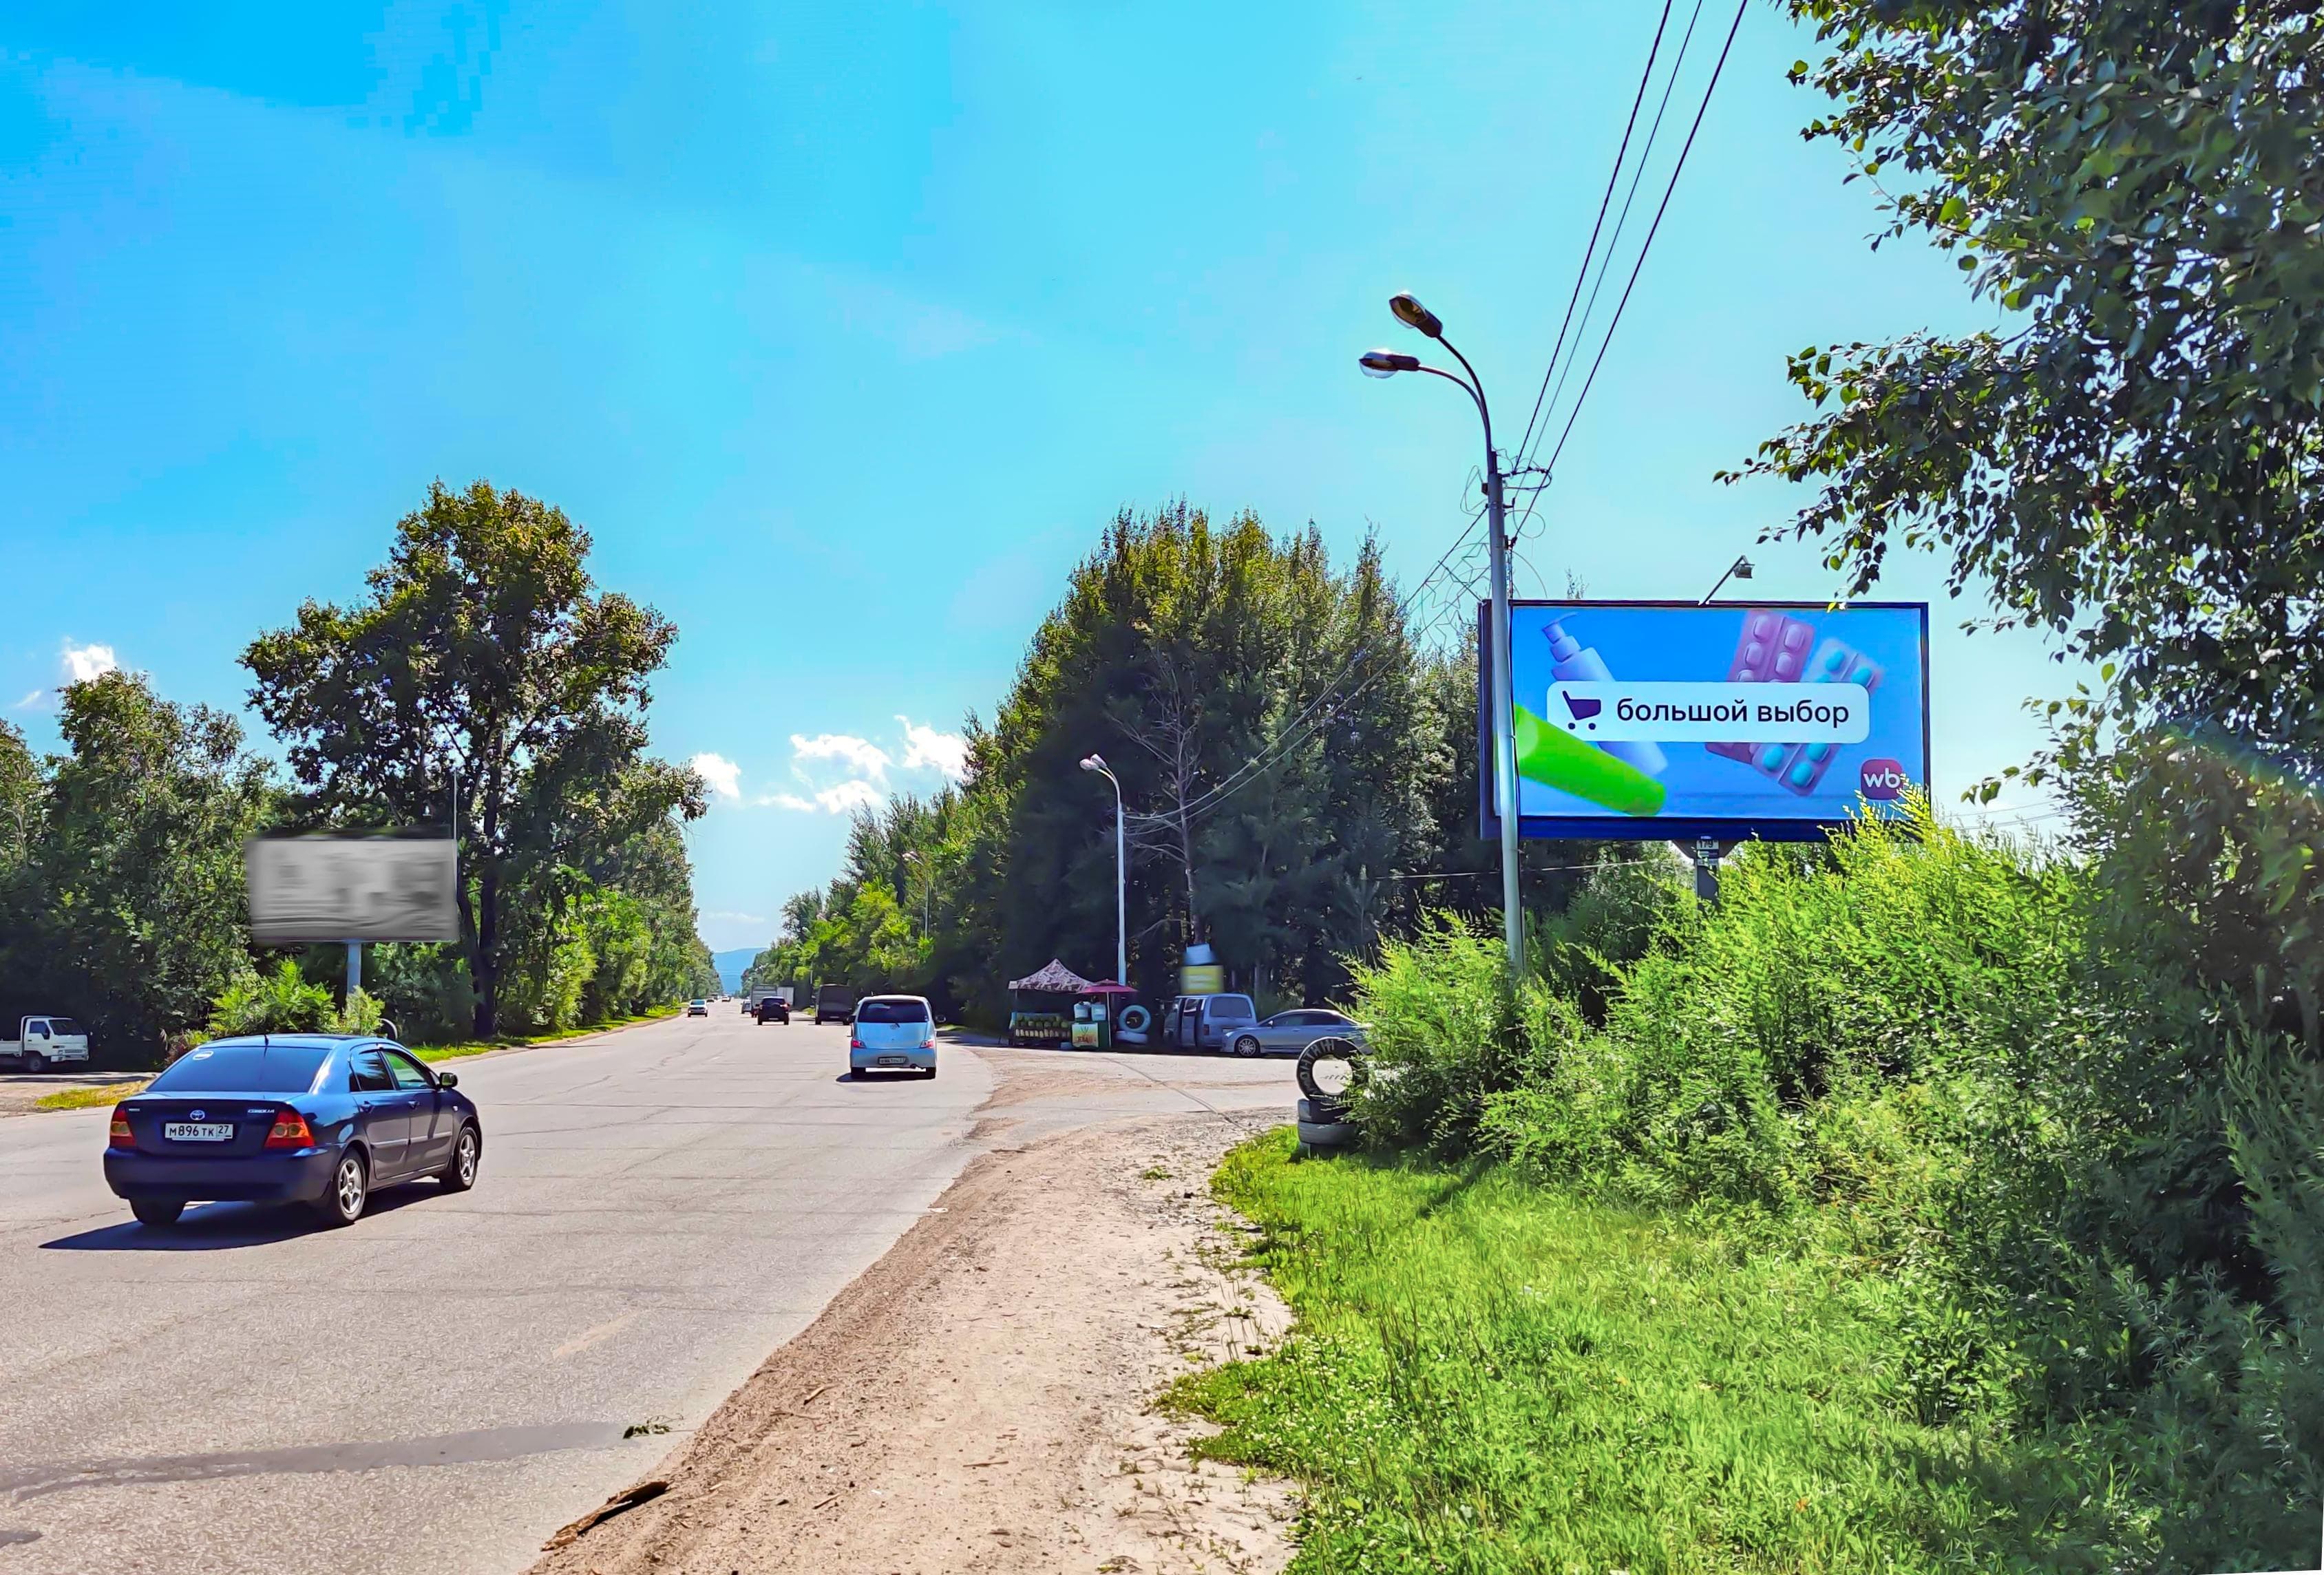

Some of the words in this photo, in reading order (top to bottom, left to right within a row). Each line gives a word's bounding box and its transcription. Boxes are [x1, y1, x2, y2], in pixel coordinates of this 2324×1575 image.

[1616, 697, 1748, 722] большой
[1757, 699, 1850, 729] выбор
[1863, 767, 1901, 788] wb
